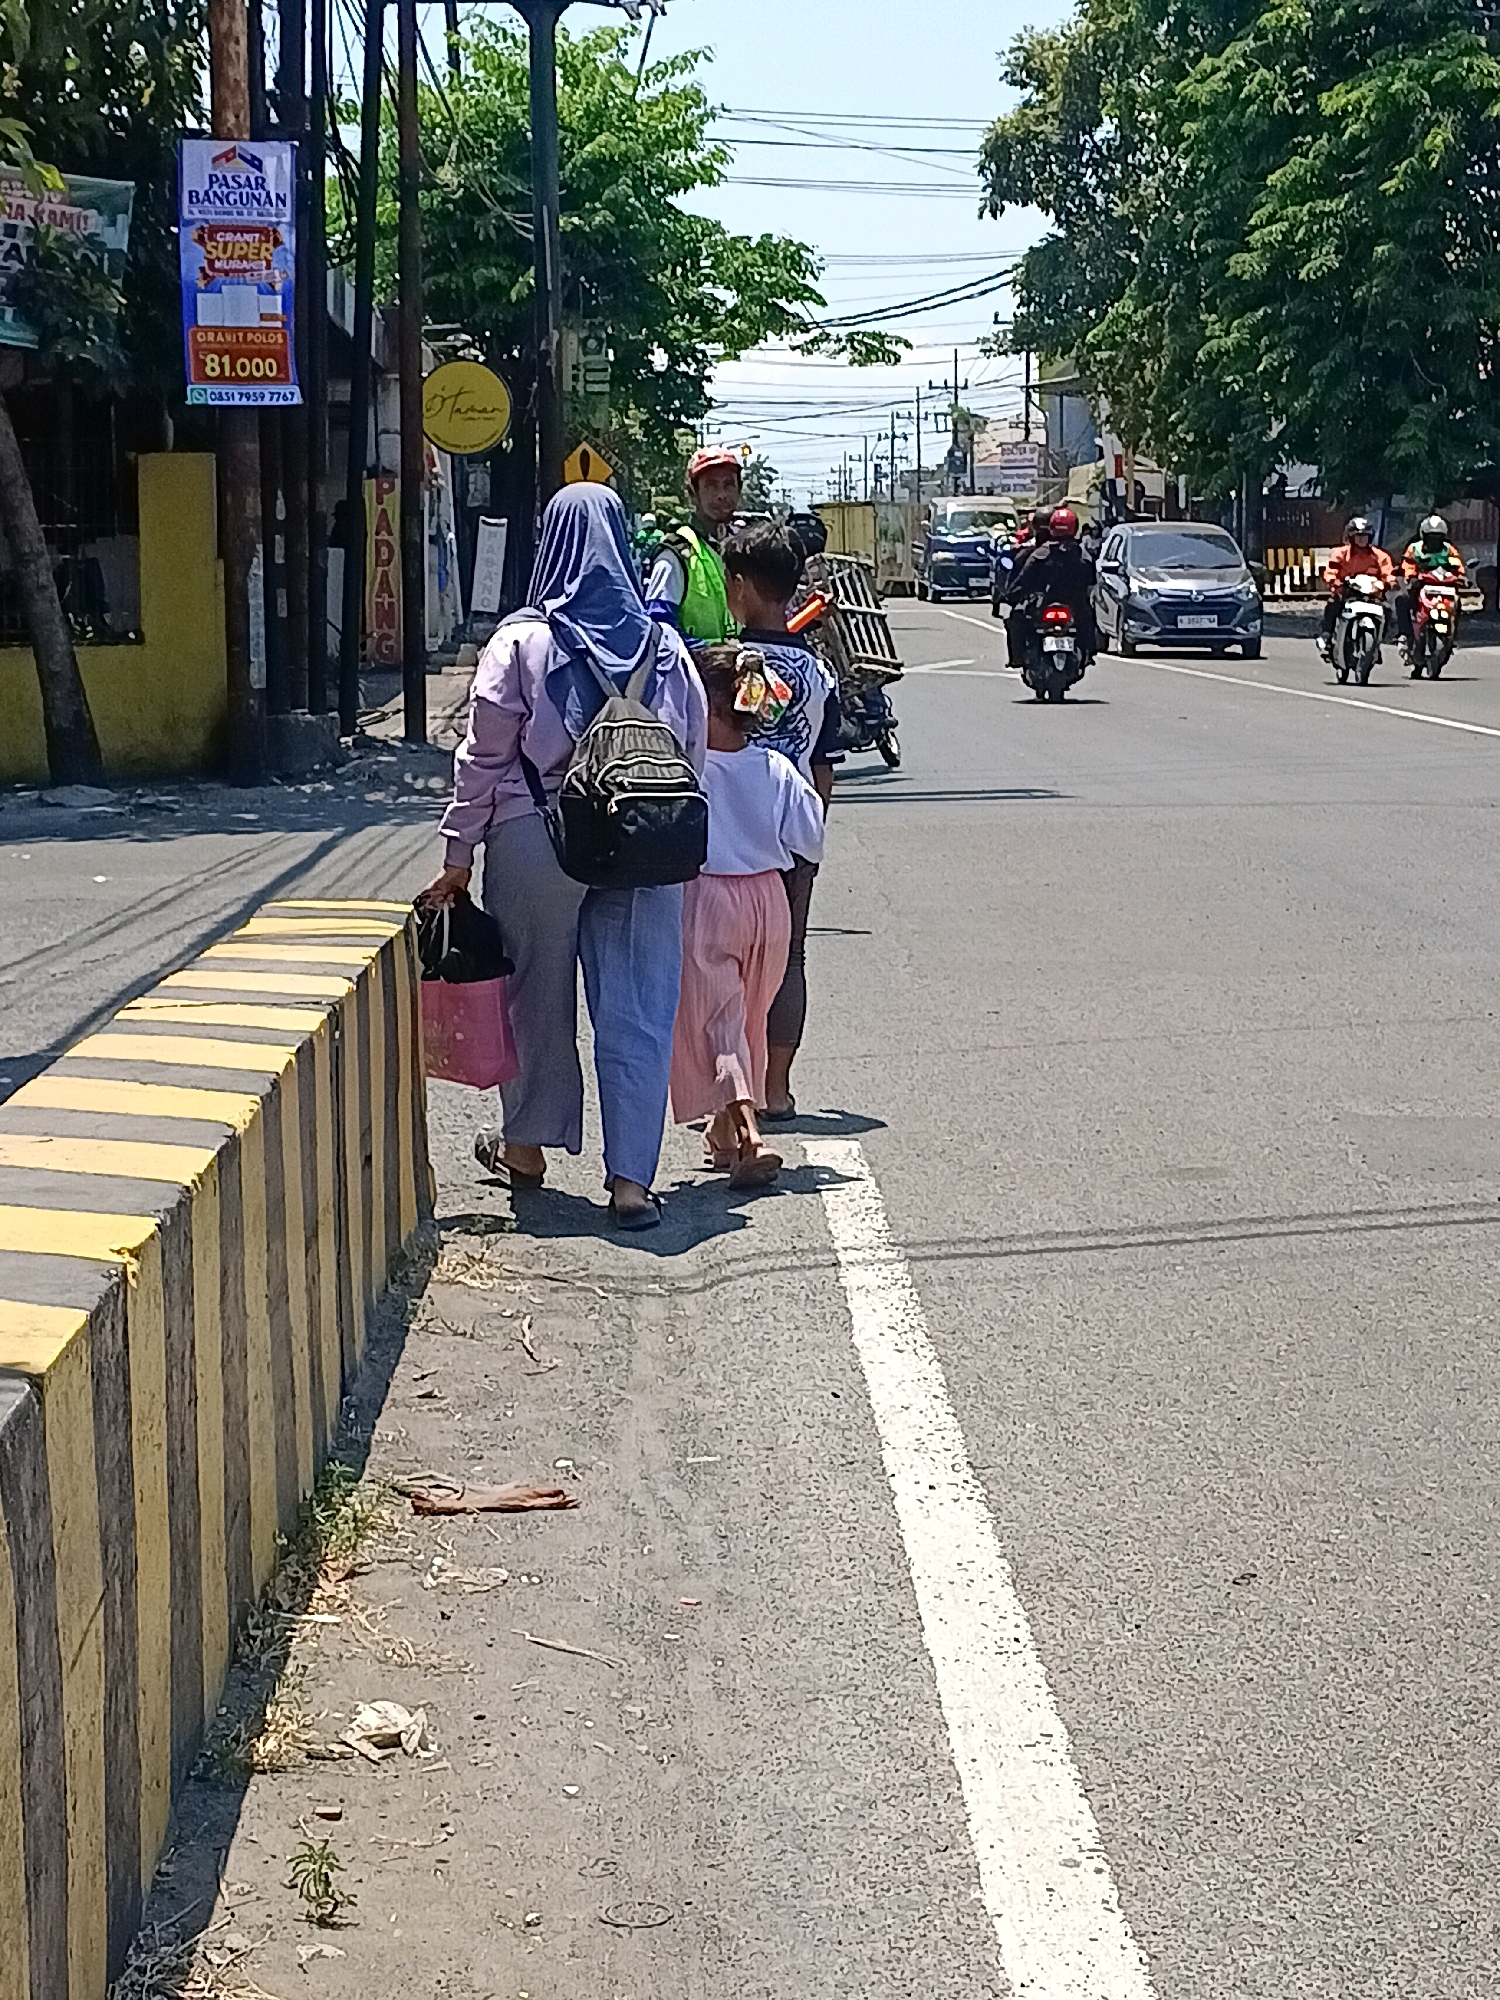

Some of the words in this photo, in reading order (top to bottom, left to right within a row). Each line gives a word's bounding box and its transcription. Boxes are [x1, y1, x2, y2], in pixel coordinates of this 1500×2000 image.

[208, 173, 267, 191] PASAR
[188, 189, 287, 208] BANGUNAN
[206, 241, 273, 260] SUPER
[197, 331, 243, 343] GRANIT
[247, 332, 284, 344] POLOS
[205, 353, 277, 378] 81.000
[374, 477, 396, 664] PADANG
